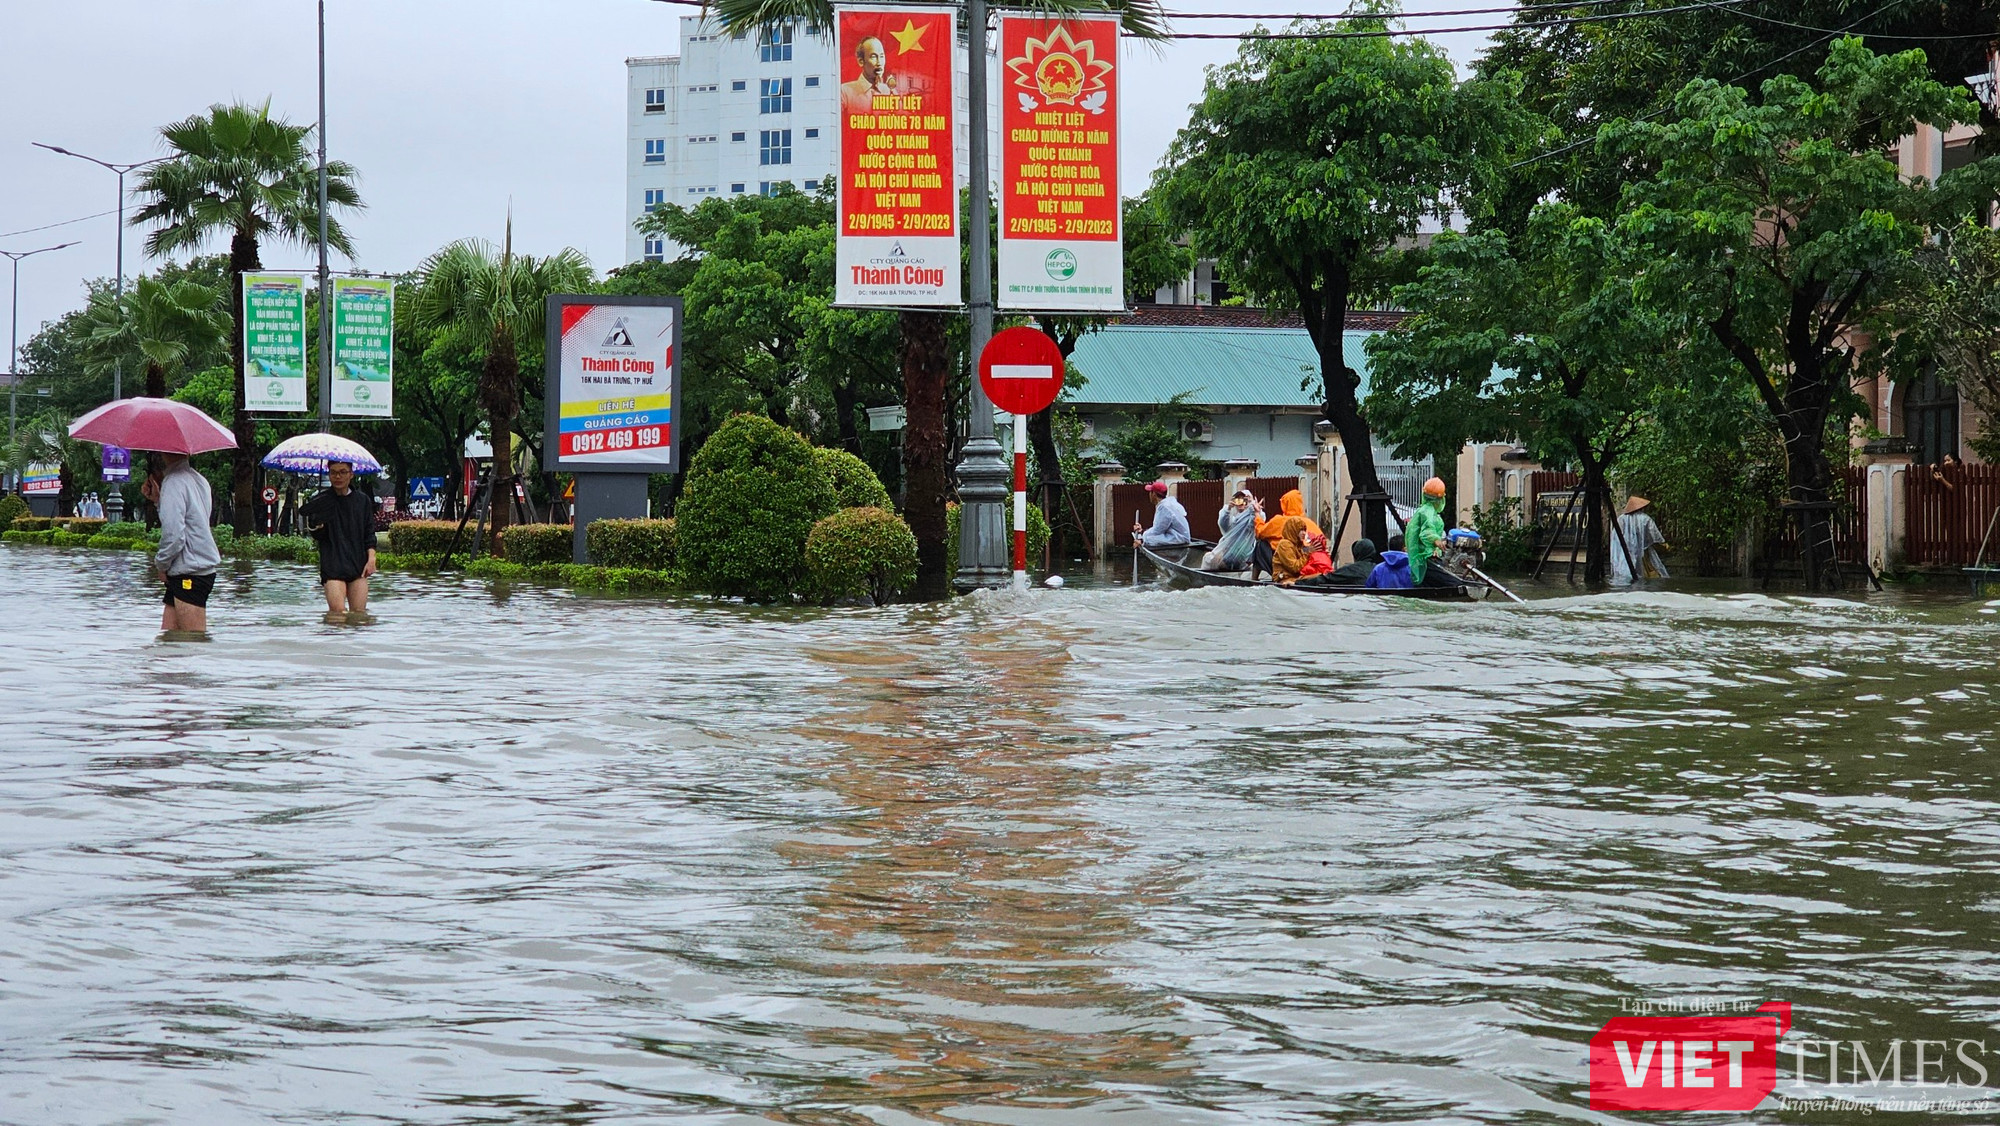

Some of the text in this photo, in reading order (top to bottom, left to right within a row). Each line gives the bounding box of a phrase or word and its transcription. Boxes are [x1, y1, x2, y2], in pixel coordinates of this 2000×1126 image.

[872, 94, 922, 112] NHIỆT LIỆT
[850, 113, 945, 130] CHÀO MỪNG 78 NĂM
[1035, 110, 1085, 128] NHIỆT LIỆT
[867, 131, 928, 150] QUỐC KHÁNH
[1012, 128, 1108, 144] CHÀO MỪNG 78 NĂM
[859, 152, 937, 170] NƯỚC CỘNG HÒA
[1029, 144, 1092, 161] QUỐC KHÁNH
[854, 171, 942, 190] XÃ HỘI CHỦ NGHĨA
[1021, 164, 1100, 180] NƯỚC CỘNG HÒA
[1016, 180, 1104, 197] XÃ HỘI CHỦ NGHĨA
[876, 192, 920, 210] VIỆT NAM
[1038, 199, 1083, 215] VIỆT NAM
[849, 214, 894, 230] 2/9/1945
[903, 214, 950, 230] 2/9/2023
[1011, 218, 1056, 232] 2/9/1945
[1066, 219, 1112, 234] 2/9/2023
[851, 266, 944, 287] Thành Công
[582, 357, 654, 374] Thành Công
[604, 376, 612, 384] BÀ
[642, 376, 653, 384] HUẾ
[599, 398, 634, 412] LIÊN HỆ
[584, 414, 649, 428] QUẢNG CÁO
[572, 427, 660, 452] 0912 469 199
